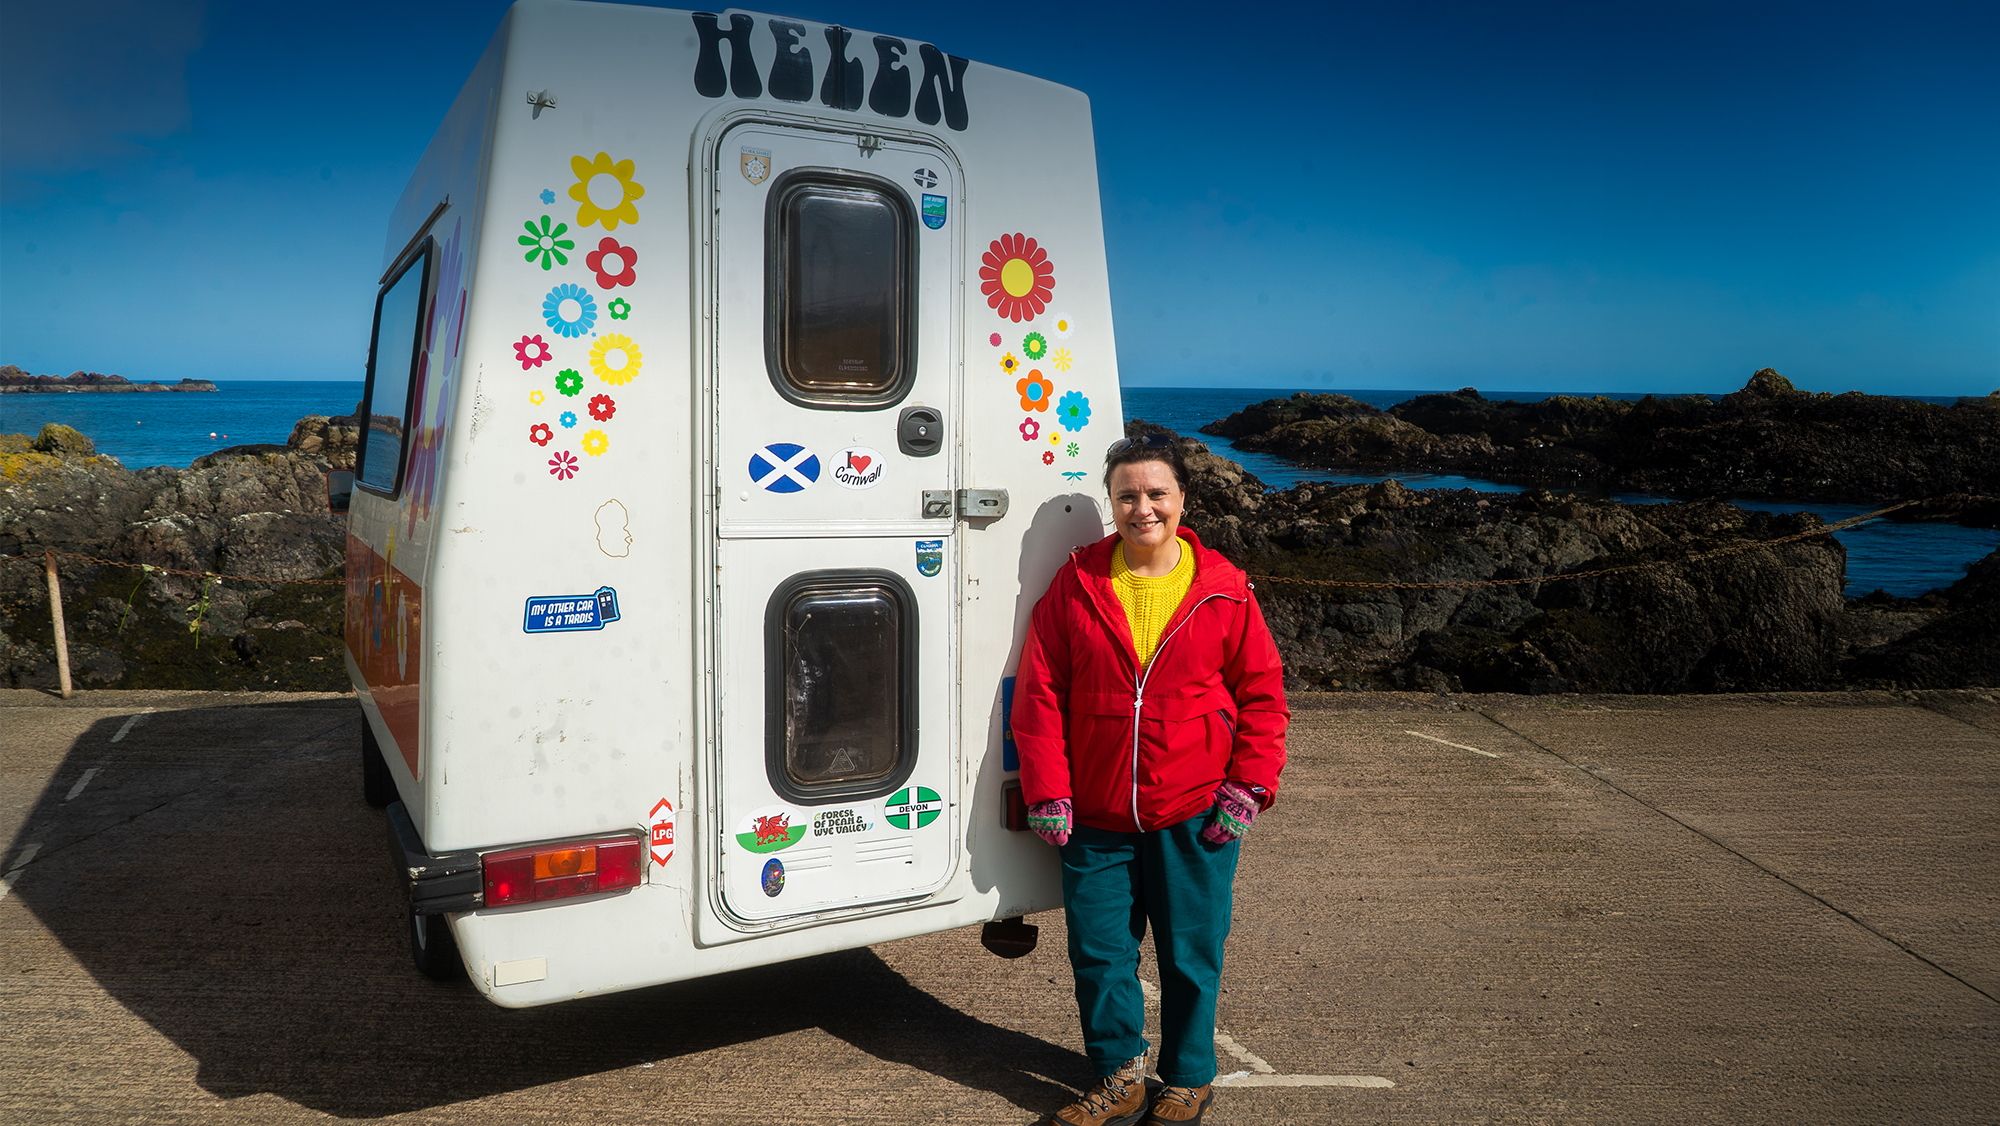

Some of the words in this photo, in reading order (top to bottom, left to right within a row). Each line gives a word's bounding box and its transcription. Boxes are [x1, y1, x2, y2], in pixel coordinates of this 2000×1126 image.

[691, 12, 969, 131] HELEN
[845, 451, 854, 469] I
[835, 463, 882, 486] Cornwall
[531, 604, 548, 616] MY
[547, 602, 575, 614] OTHER
[576, 600, 594, 612] CAR
[544, 616, 554, 627] IS
[555, 615, 562, 626] A
[564, 612, 594, 625] TARDIS
[899, 803, 928, 813] DEVON
[856, 815, 863, 824] &
[1031, 820, 1065, 830] FEAR
[653, 828, 673, 841] LPG
[814, 827, 834, 837] WYE
[835, 823, 867, 834] VALLEY
